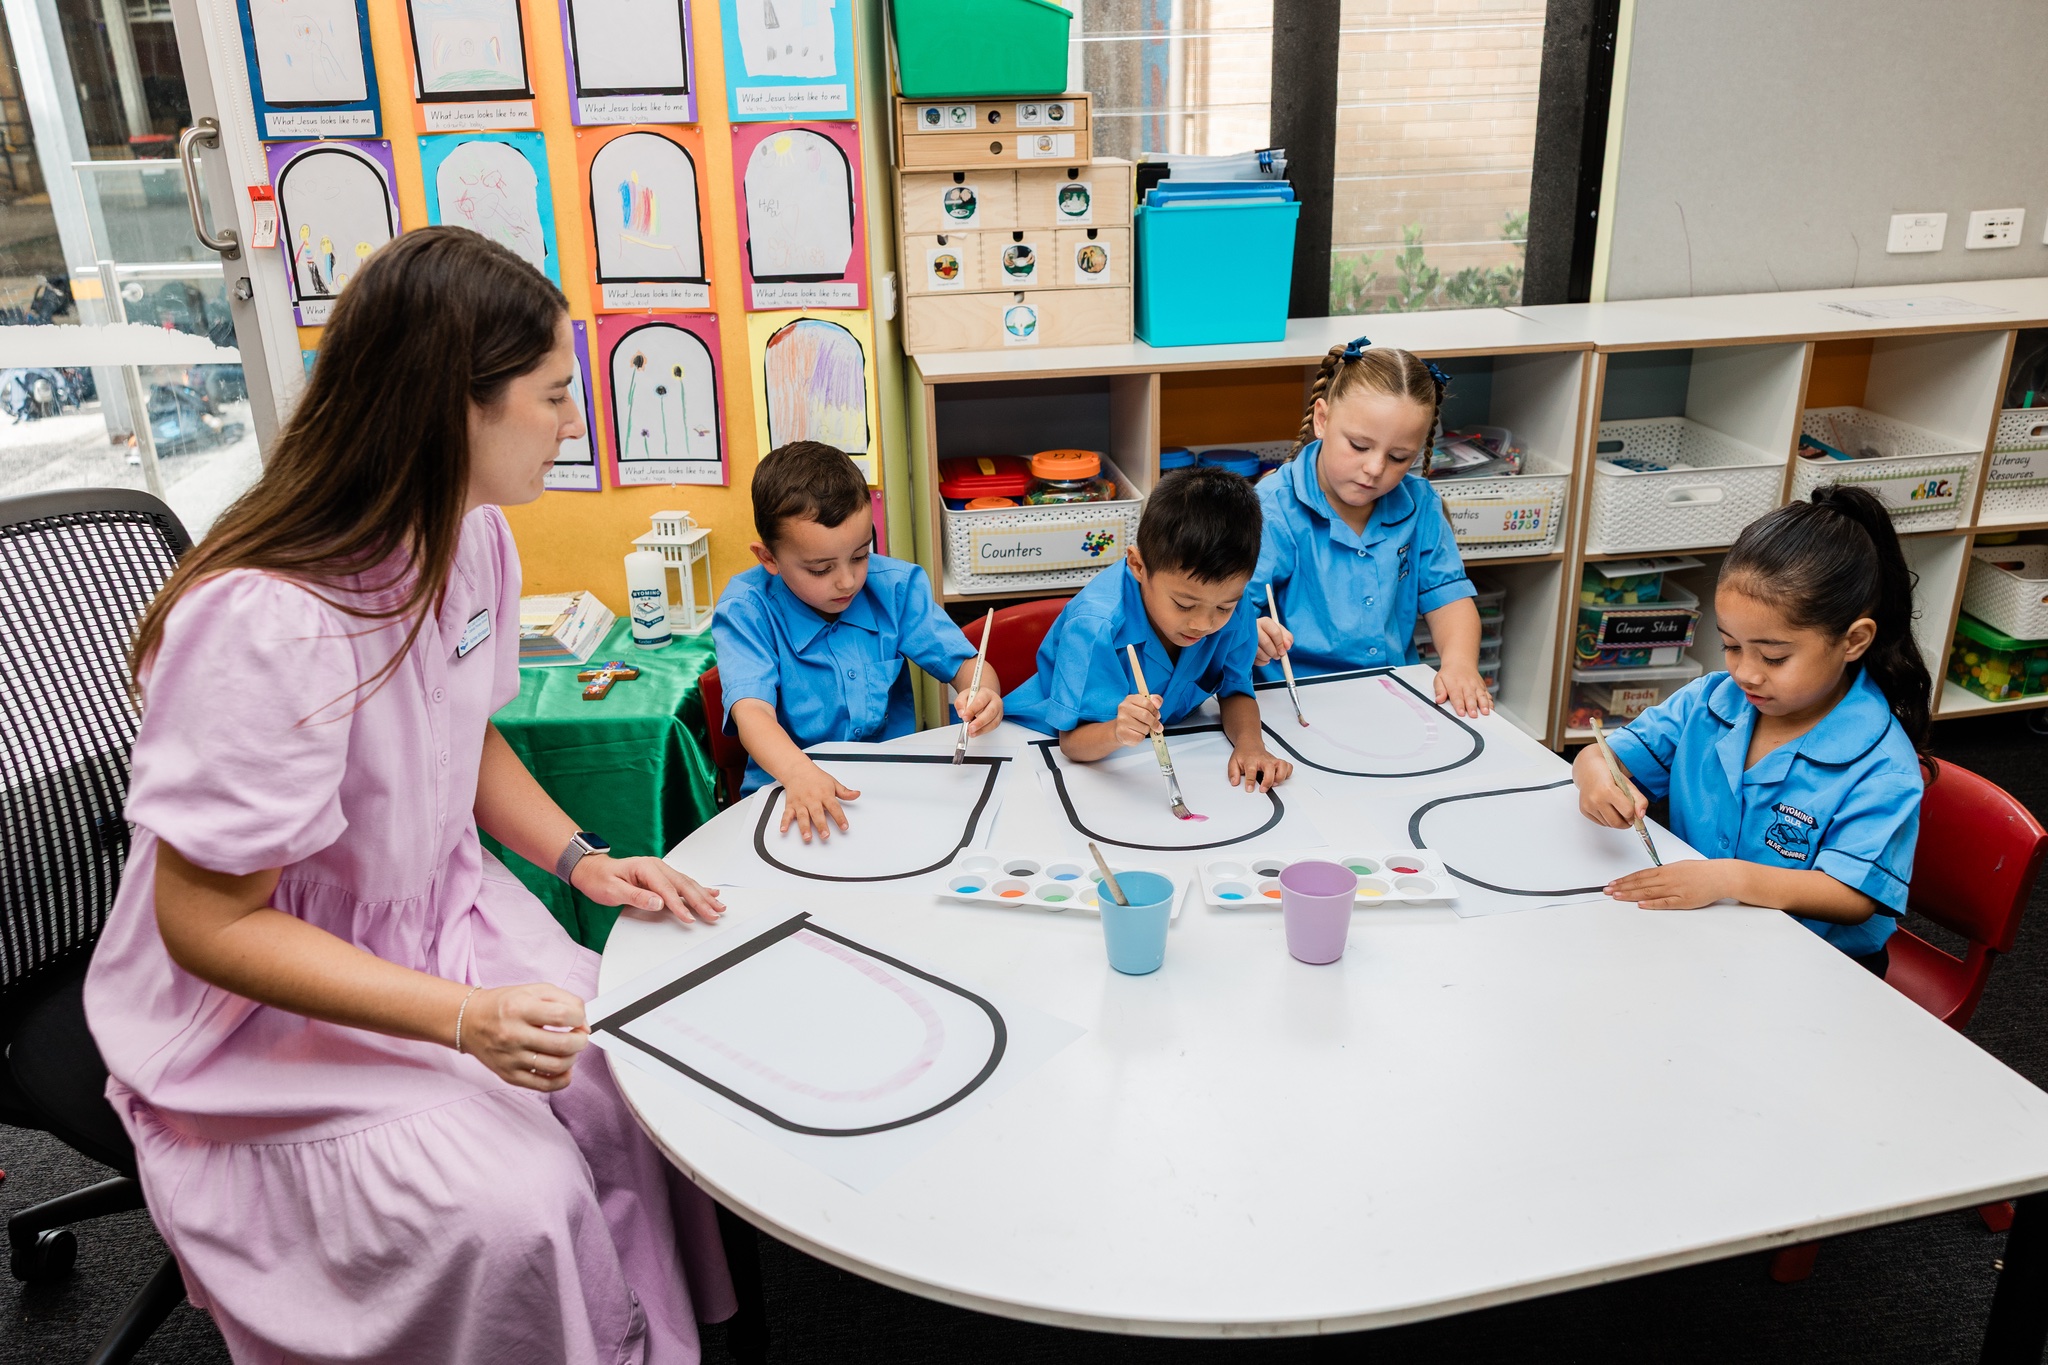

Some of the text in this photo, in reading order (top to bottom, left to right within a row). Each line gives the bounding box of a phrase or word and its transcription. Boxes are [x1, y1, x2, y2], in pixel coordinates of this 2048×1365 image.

[742, 94, 762, 103] What
[766, 93, 785, 102] Jesus
[788, 92, 804, 101] looks
[807, 92, 818, 100] like
[821, 92, 828, 100] to
[585, 104, 605, 113] What
[609, 103, 628, 112] Jesus
[632, 103, 647, 111] looks
[650, 102, 661, 111] like
[664, 102, 670, 110] to
[431, 111, 451, 120] What
[454, 111, 474, 119] Jesus
[477, 110, 493, 118] looks
[496, 109, 506, 118] like
[510, 109, 516, 117] to
[272, 116, 294, 125] What
[297, 116, 318, 125] Jesus
[320, 116, 336, 124] looks
[339, 116, 349, 124] like
[608, 290, 628, 298] What
[756, 289, 776, 298] What
[779, 289, 798, 298] Jesus
[801, 289, 816, 297] looks
[820, 289, 829, 297] like
[1992, 455, 2030, 468] Literacy
[1989, 468, 2034, 481] Resources
[1451, 509, 1479, 520] matics
[1505, 508, 1541, 519] 01234
[1503, 519, 1539, 531] 56789
[981, 542, 1042, 559] Counters
[1616, 622, 1677, 634] Clever Sticks
[1623, 690, 1654, 700] Beads
[1779, 804, 1814, 825] WYOMING
[1767, 839, 1781, 851] ALIVE
